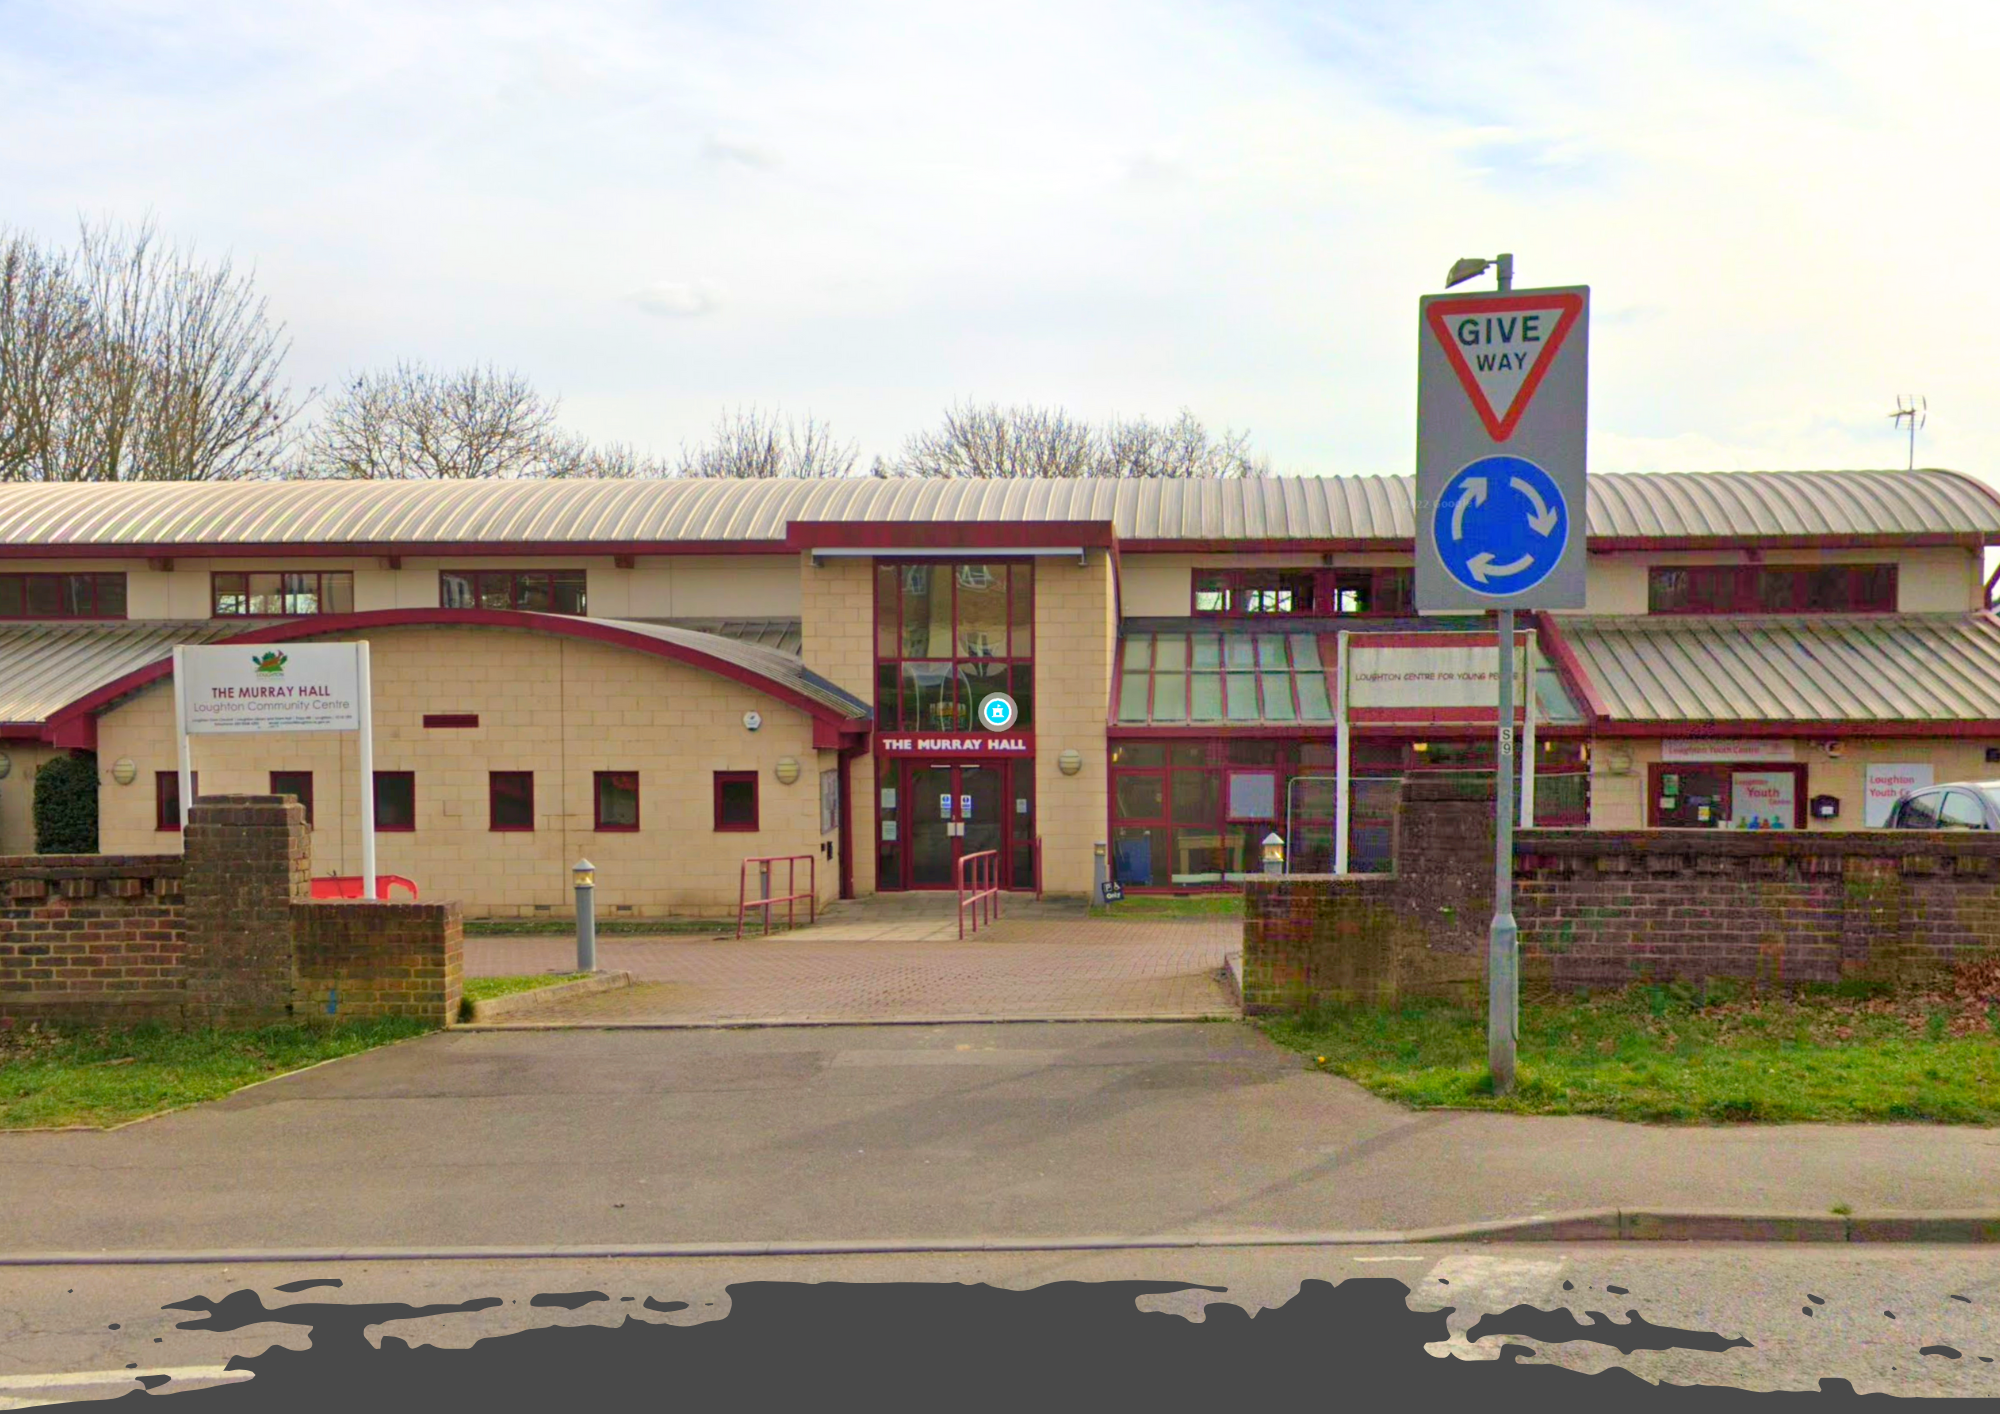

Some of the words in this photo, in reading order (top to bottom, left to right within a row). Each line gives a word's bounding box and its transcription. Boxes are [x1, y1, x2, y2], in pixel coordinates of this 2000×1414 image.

[1458, 316, 1538, 345] GIVE
[1476, 352, 1526, 371] WAY
[1355, 673, 1400, 681] LOUGHTON
[1457, 672, 1486, 680] YOUNG
[1488, 672, 1518, 680] PEE
[212, 688, 234, 698] THE
[239, 687, 294, 698] MURRAY
[299, 686, 330, 697] HALL
[194, 702, 244, 714] Loughton
[248, 700, 309, 712] Community
[313, 700, 349, 710] Centre
[1502, 729, 1511, 741] S
[883, 738, 912, 749] THE
[917, 738, 982, 749] MURRAY
[988, 738, 1026, 749] HALL
[1870, 775, 1915, 786] Loughton
[1747, 787, 1780, 798] Youth
[1870, 788, 1896, 798] Youth
